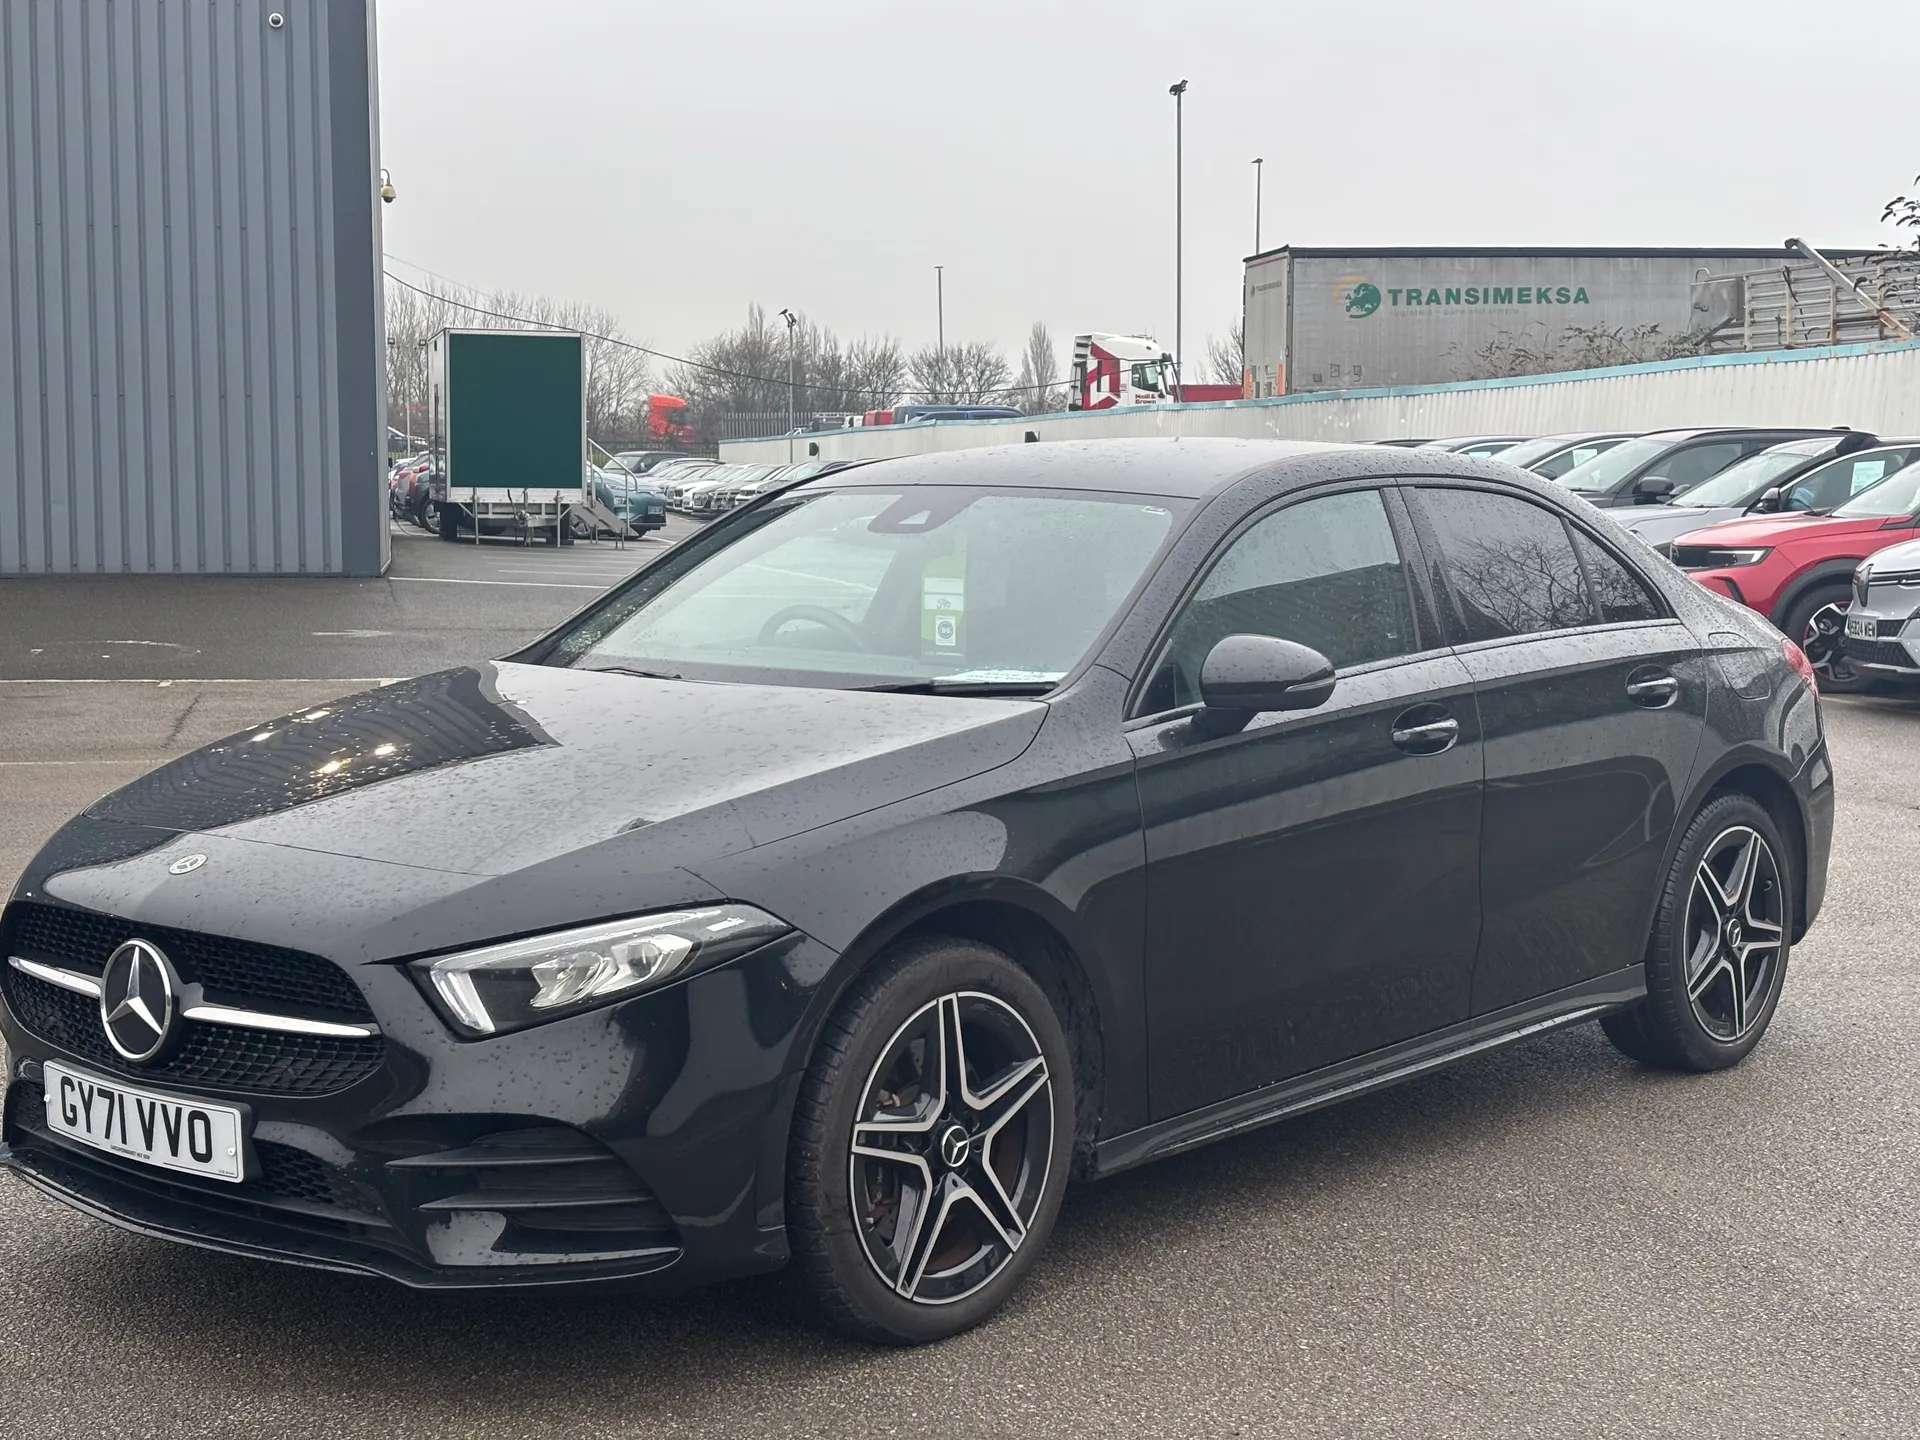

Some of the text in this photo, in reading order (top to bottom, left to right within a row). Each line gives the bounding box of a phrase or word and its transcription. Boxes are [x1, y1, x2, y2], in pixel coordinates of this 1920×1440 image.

[1387, 287, 1591, 306] TRANSIMEKSA
[60, 1076, 213, 1163] GY71 VVO
